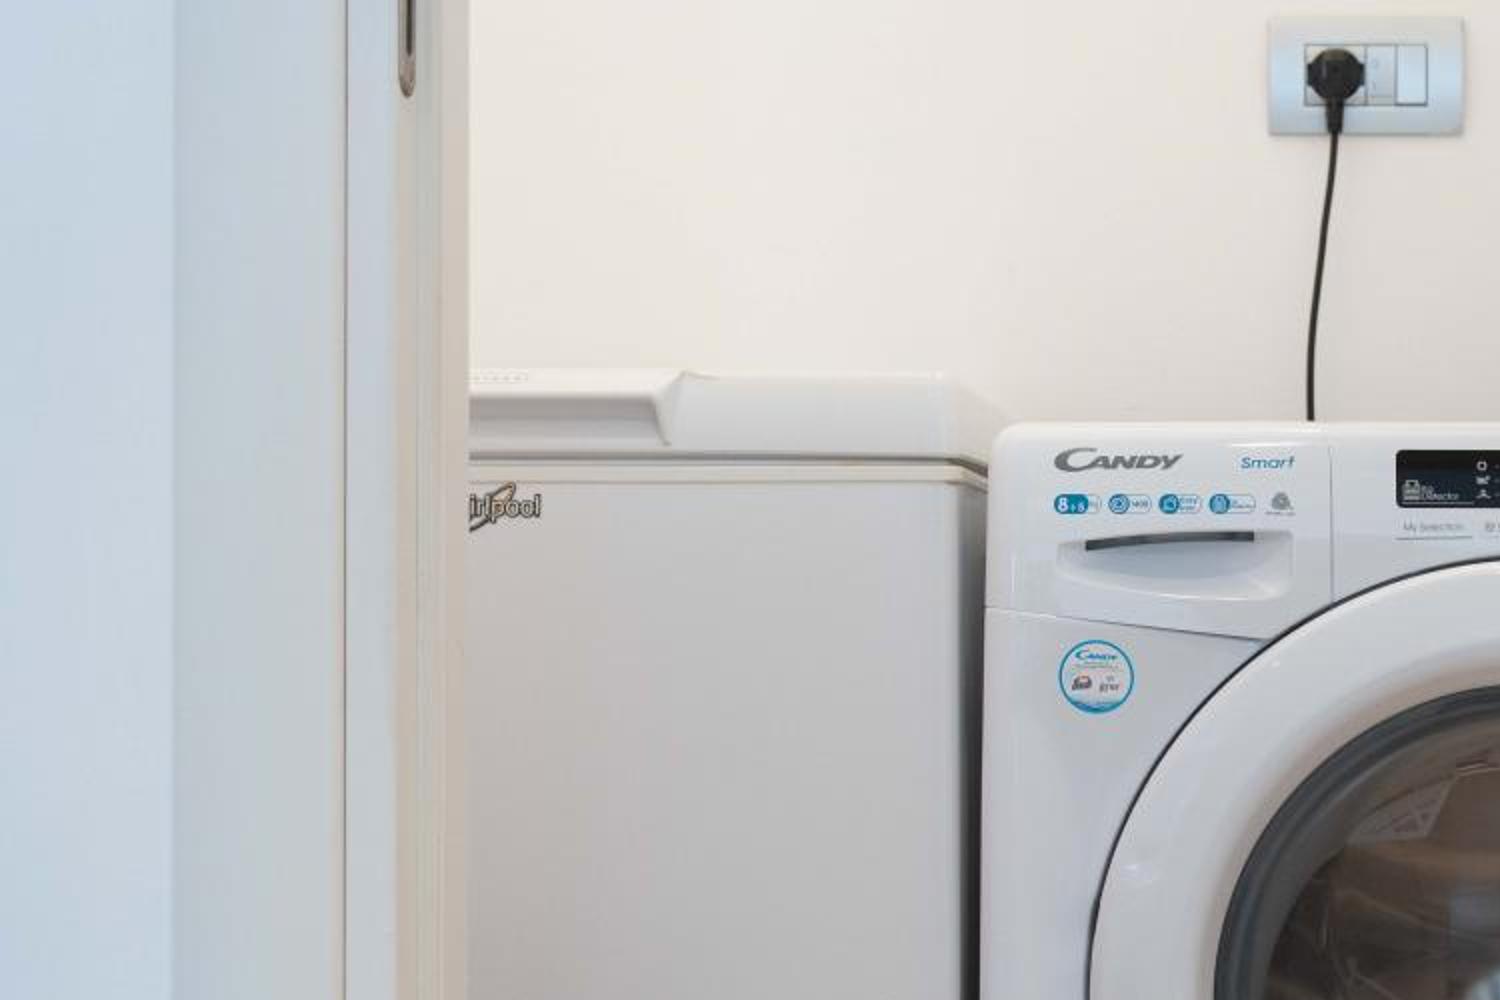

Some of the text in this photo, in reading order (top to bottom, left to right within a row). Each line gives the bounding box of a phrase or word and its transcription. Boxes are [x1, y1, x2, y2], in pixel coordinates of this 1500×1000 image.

[1054, 448, 1183, 472] CANDY
[1240, 455, 1296, 469] Smart
[469, 481, 541, 532] irlpool
